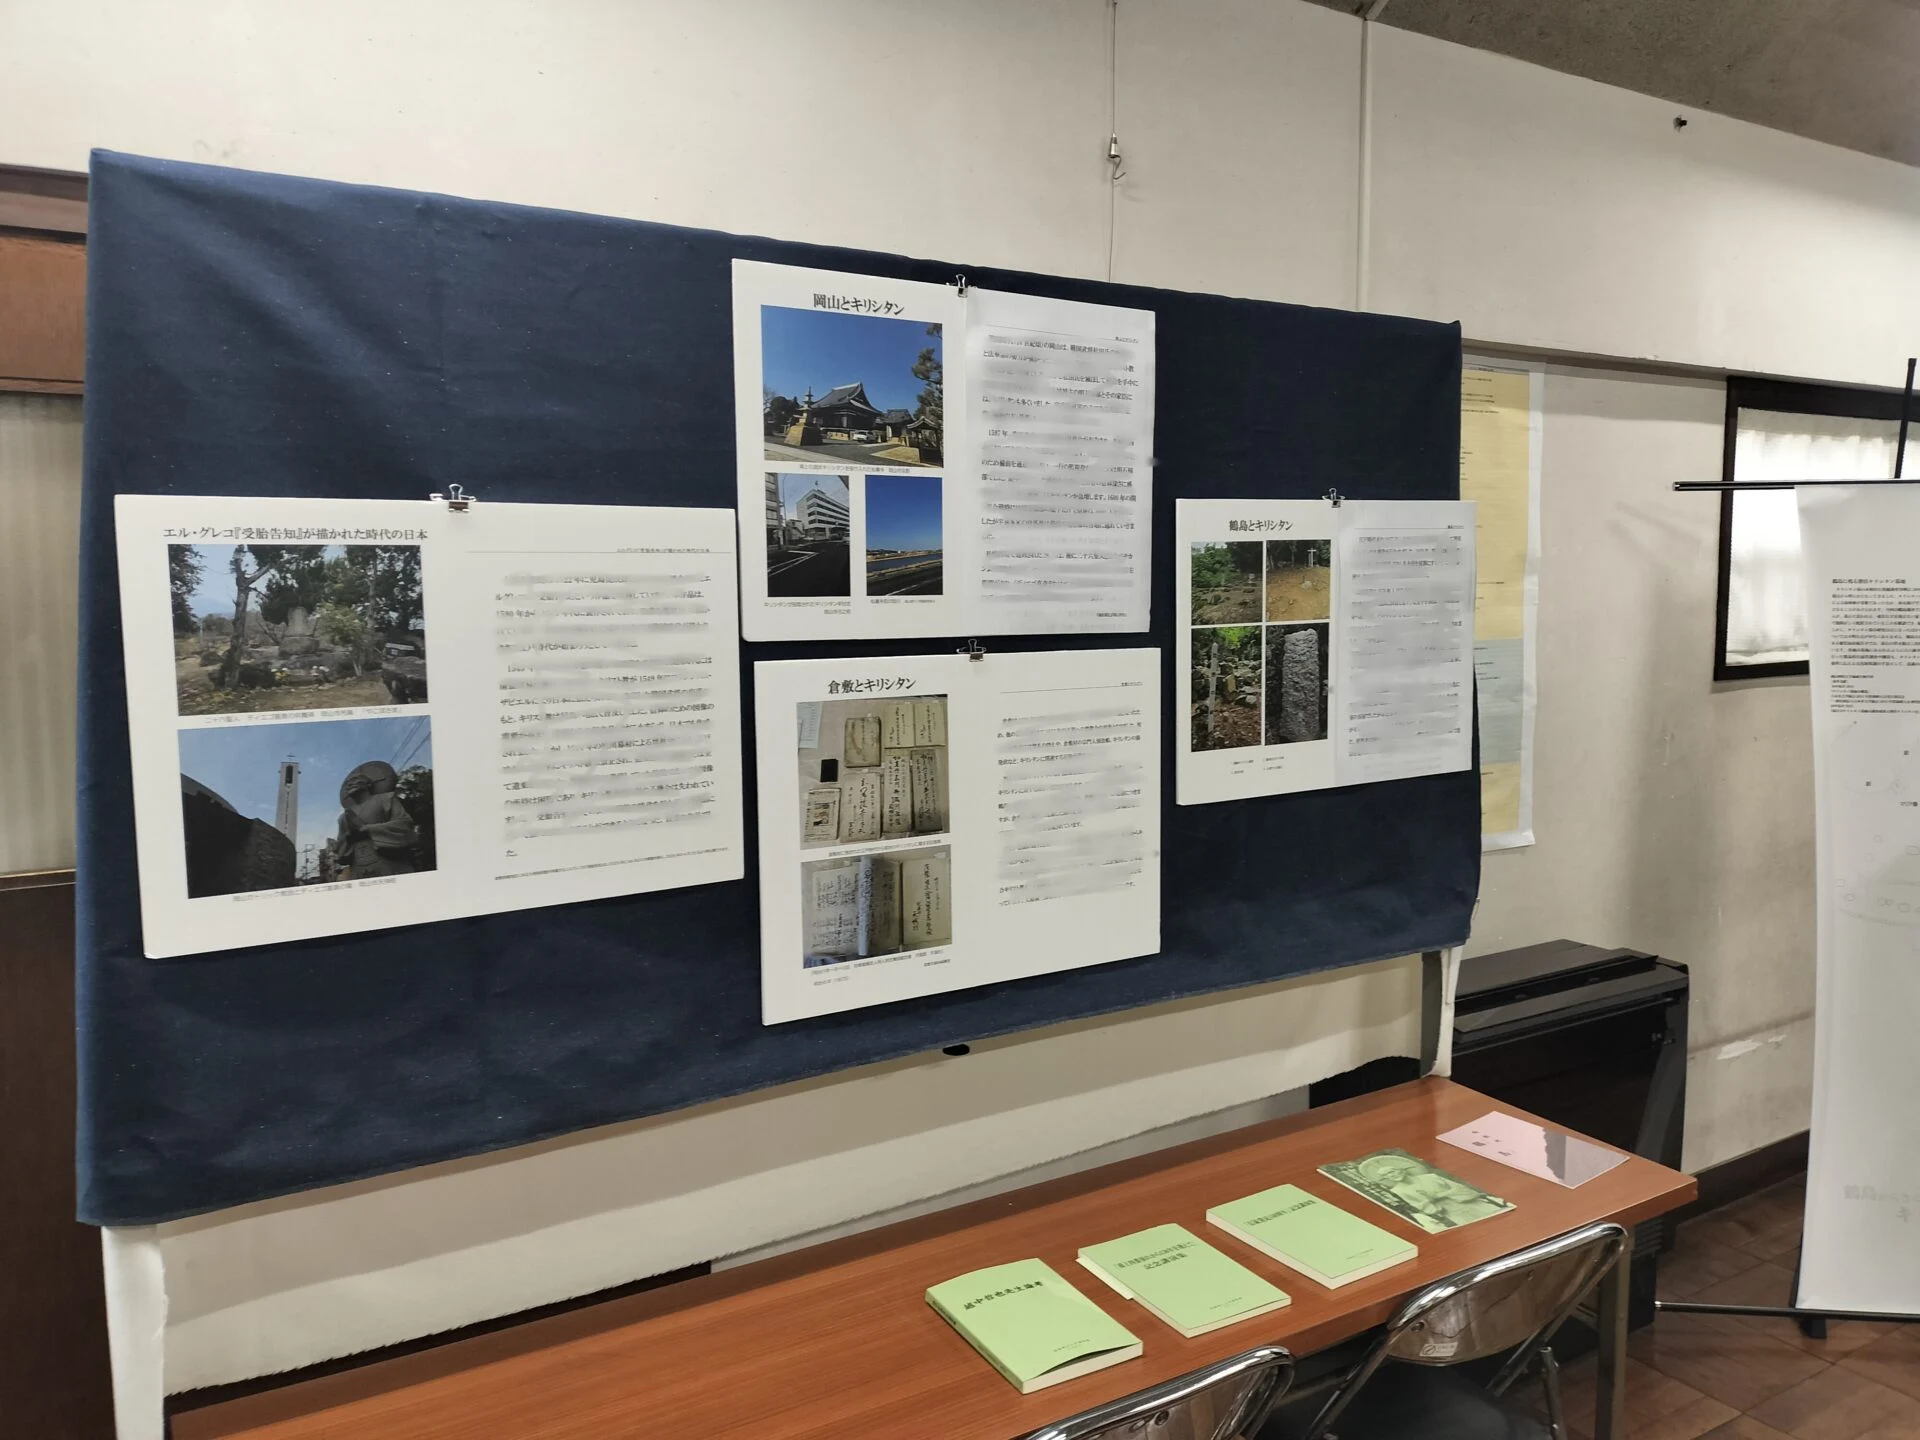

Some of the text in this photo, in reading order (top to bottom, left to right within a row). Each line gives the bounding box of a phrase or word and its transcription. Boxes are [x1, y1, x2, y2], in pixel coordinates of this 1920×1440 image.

[813, 293, 905, 316] 岡山とキリシタン
[163, 526, 428, 540] エル・グレコ『受胎告知』が描かれた時代の日本
[1229, 519, 1294, 532] 鶴島とキリシタン
[828, 676, 917, 694] 倉敷とキリシタン
